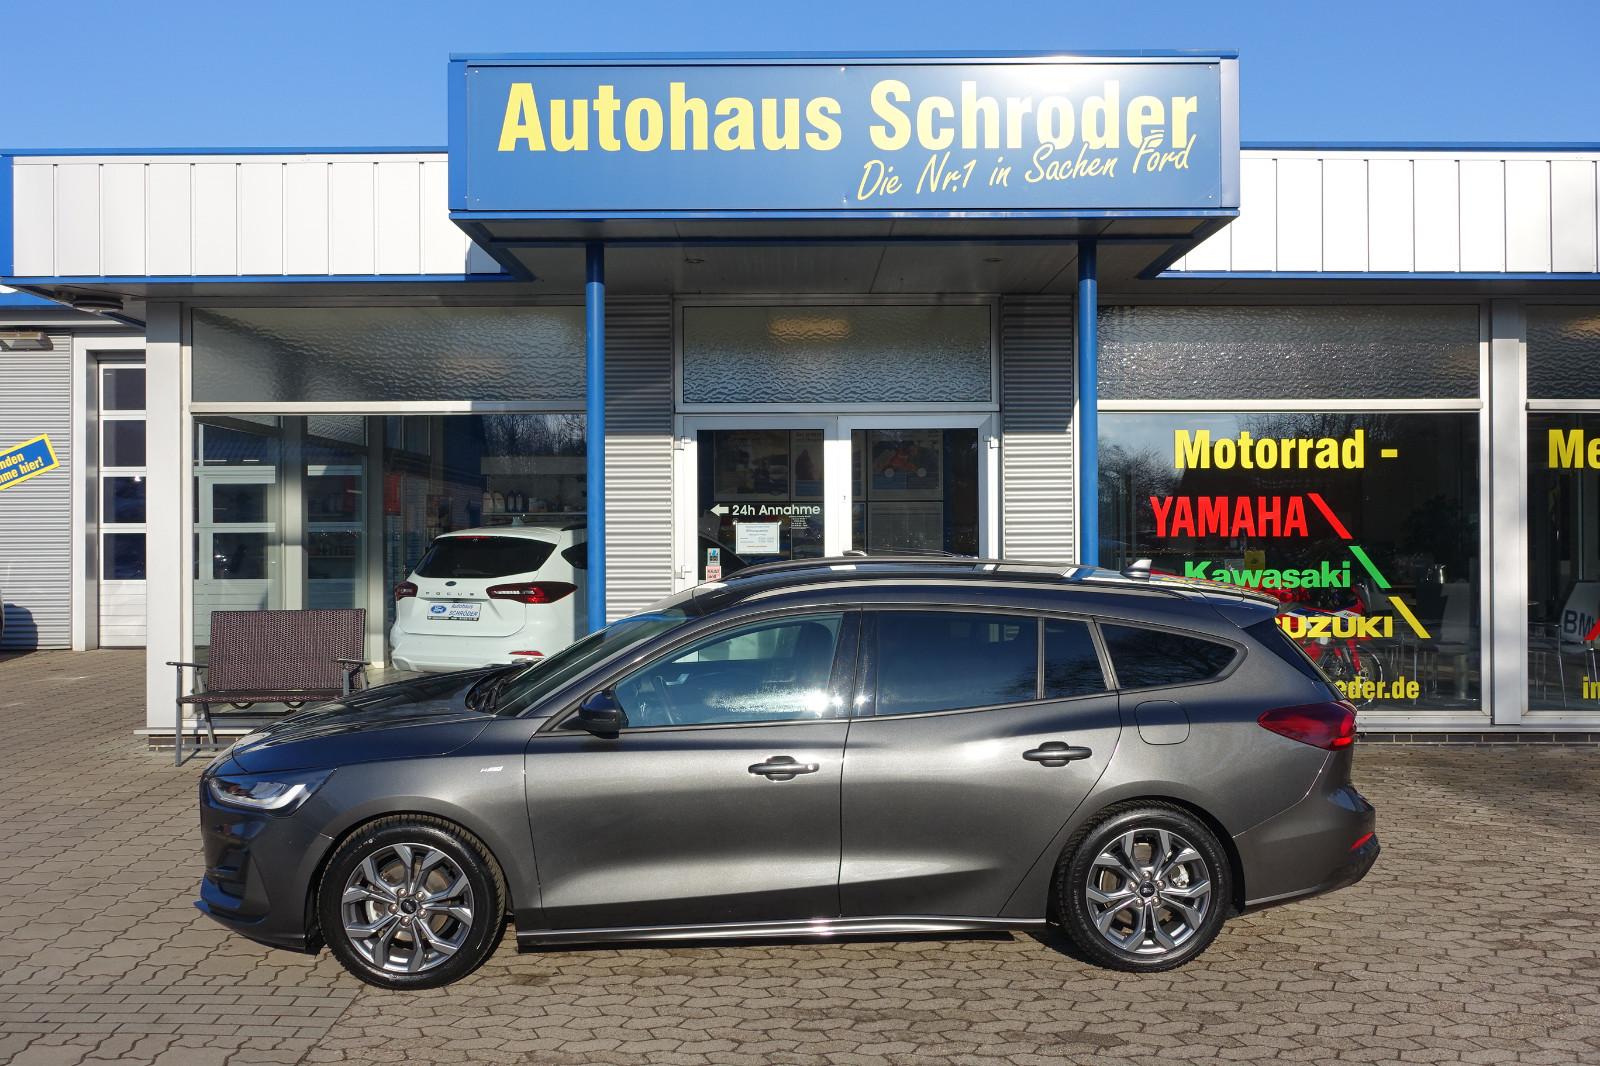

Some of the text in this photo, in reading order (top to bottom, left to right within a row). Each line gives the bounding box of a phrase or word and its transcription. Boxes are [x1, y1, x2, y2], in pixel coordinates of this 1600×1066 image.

[498, 82, 843, 152] Autohaus
[857, 159, 902, 200] Die
[989, 156, 1012, 187] in
[1024, 140, 1119, 183] Sachen
[1132, 129, 1198, 174] Ford
[19, 456, 44, 474] hier!
[1174, 429, 1364, 469] Motorrad
[732, 504, 820, 516] 24h Annahme
[1150, 496, 1309, 537] YAMAHA
[1184, 561, 1351, 588] Kawasaki
